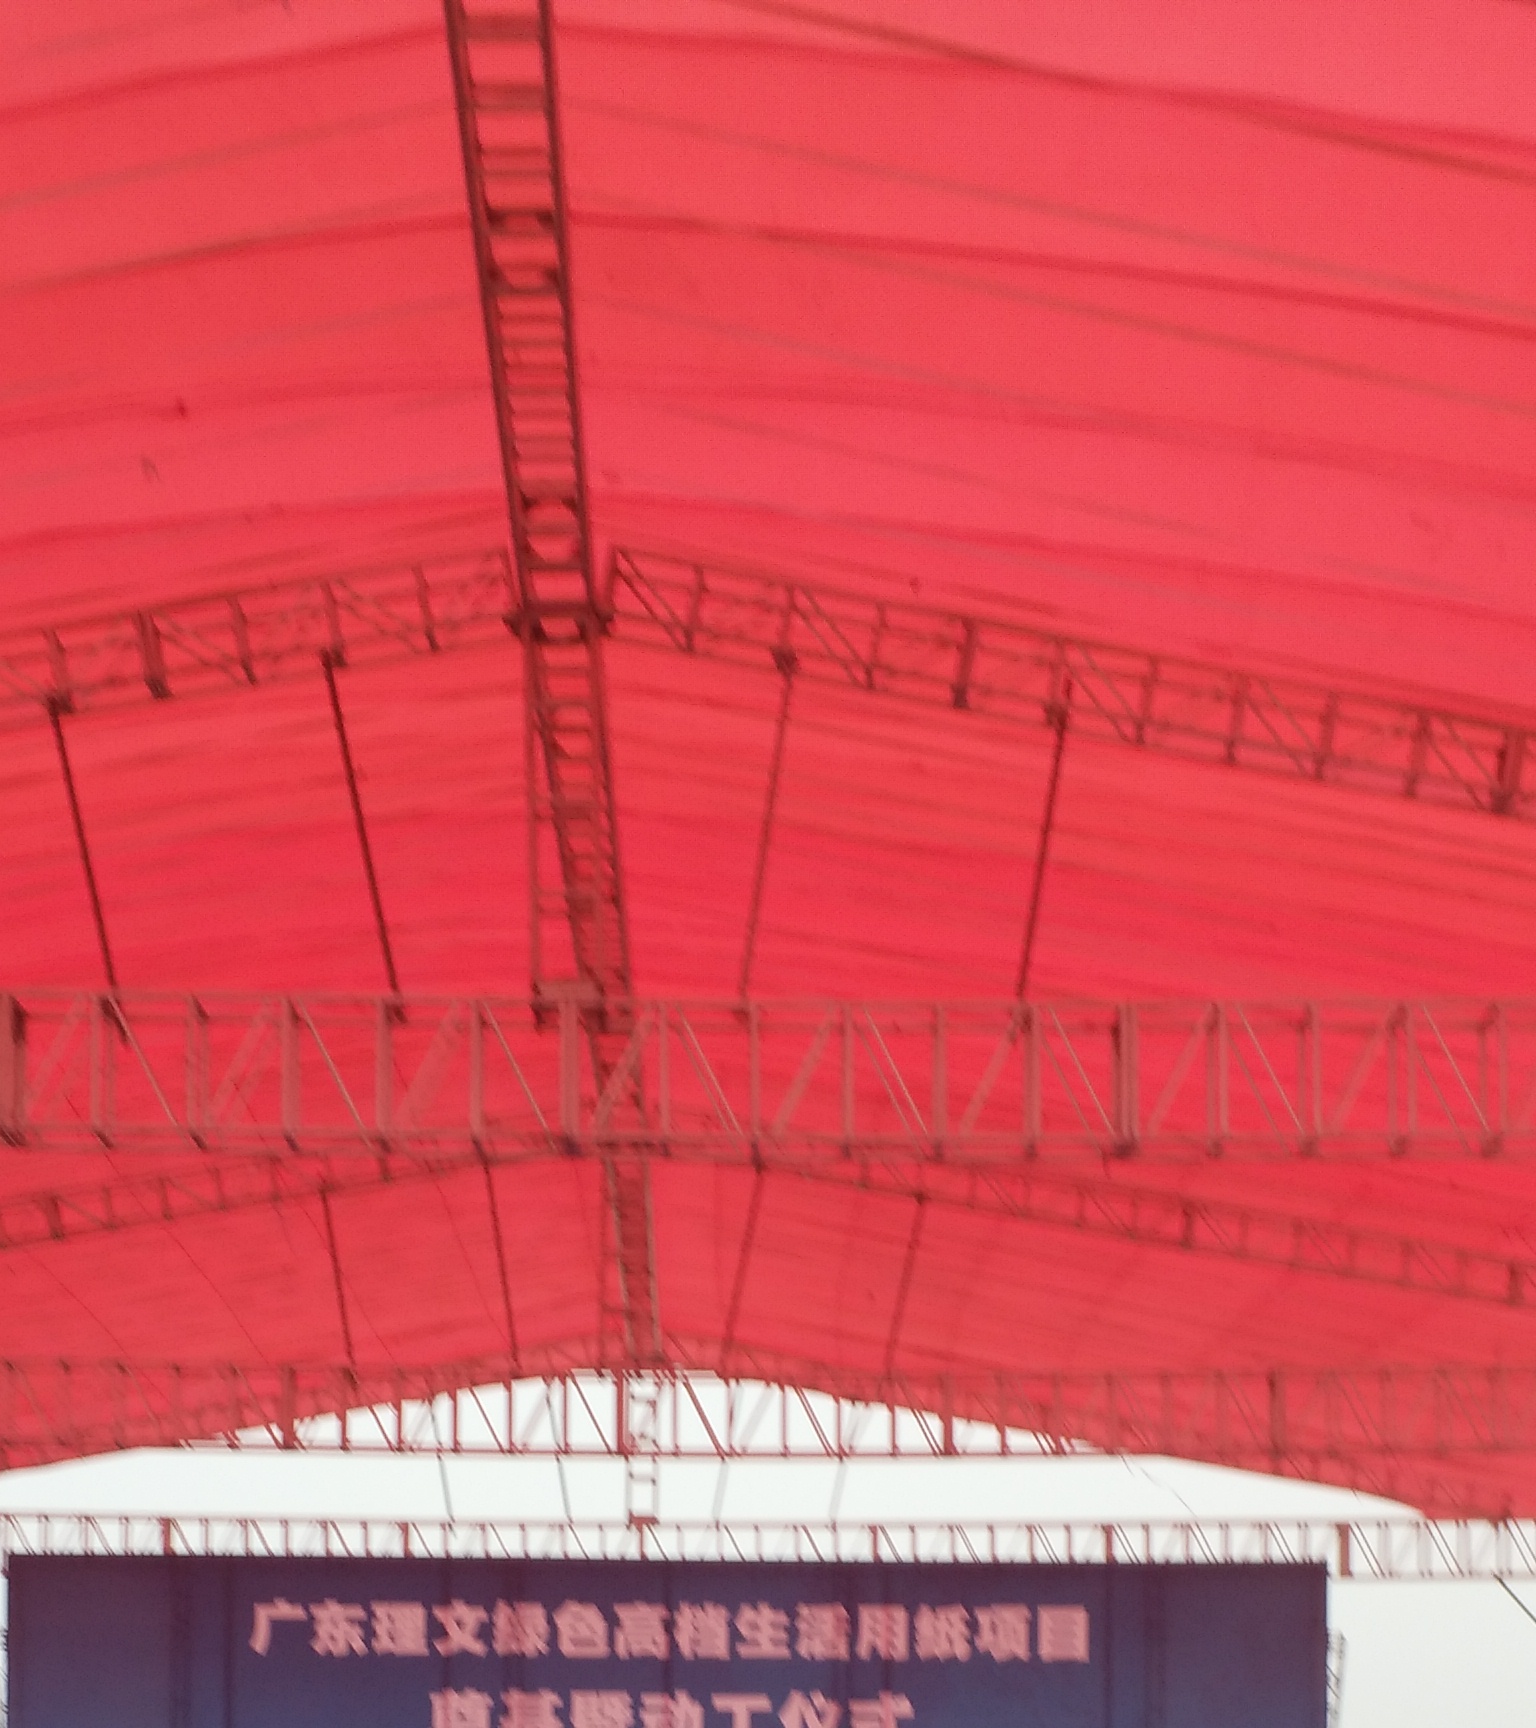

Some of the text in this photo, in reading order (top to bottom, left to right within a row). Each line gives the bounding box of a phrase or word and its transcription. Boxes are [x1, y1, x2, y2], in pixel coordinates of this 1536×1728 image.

[249, 1598, 1090, 1663] 广东理文绿色高档生活用纸项目
